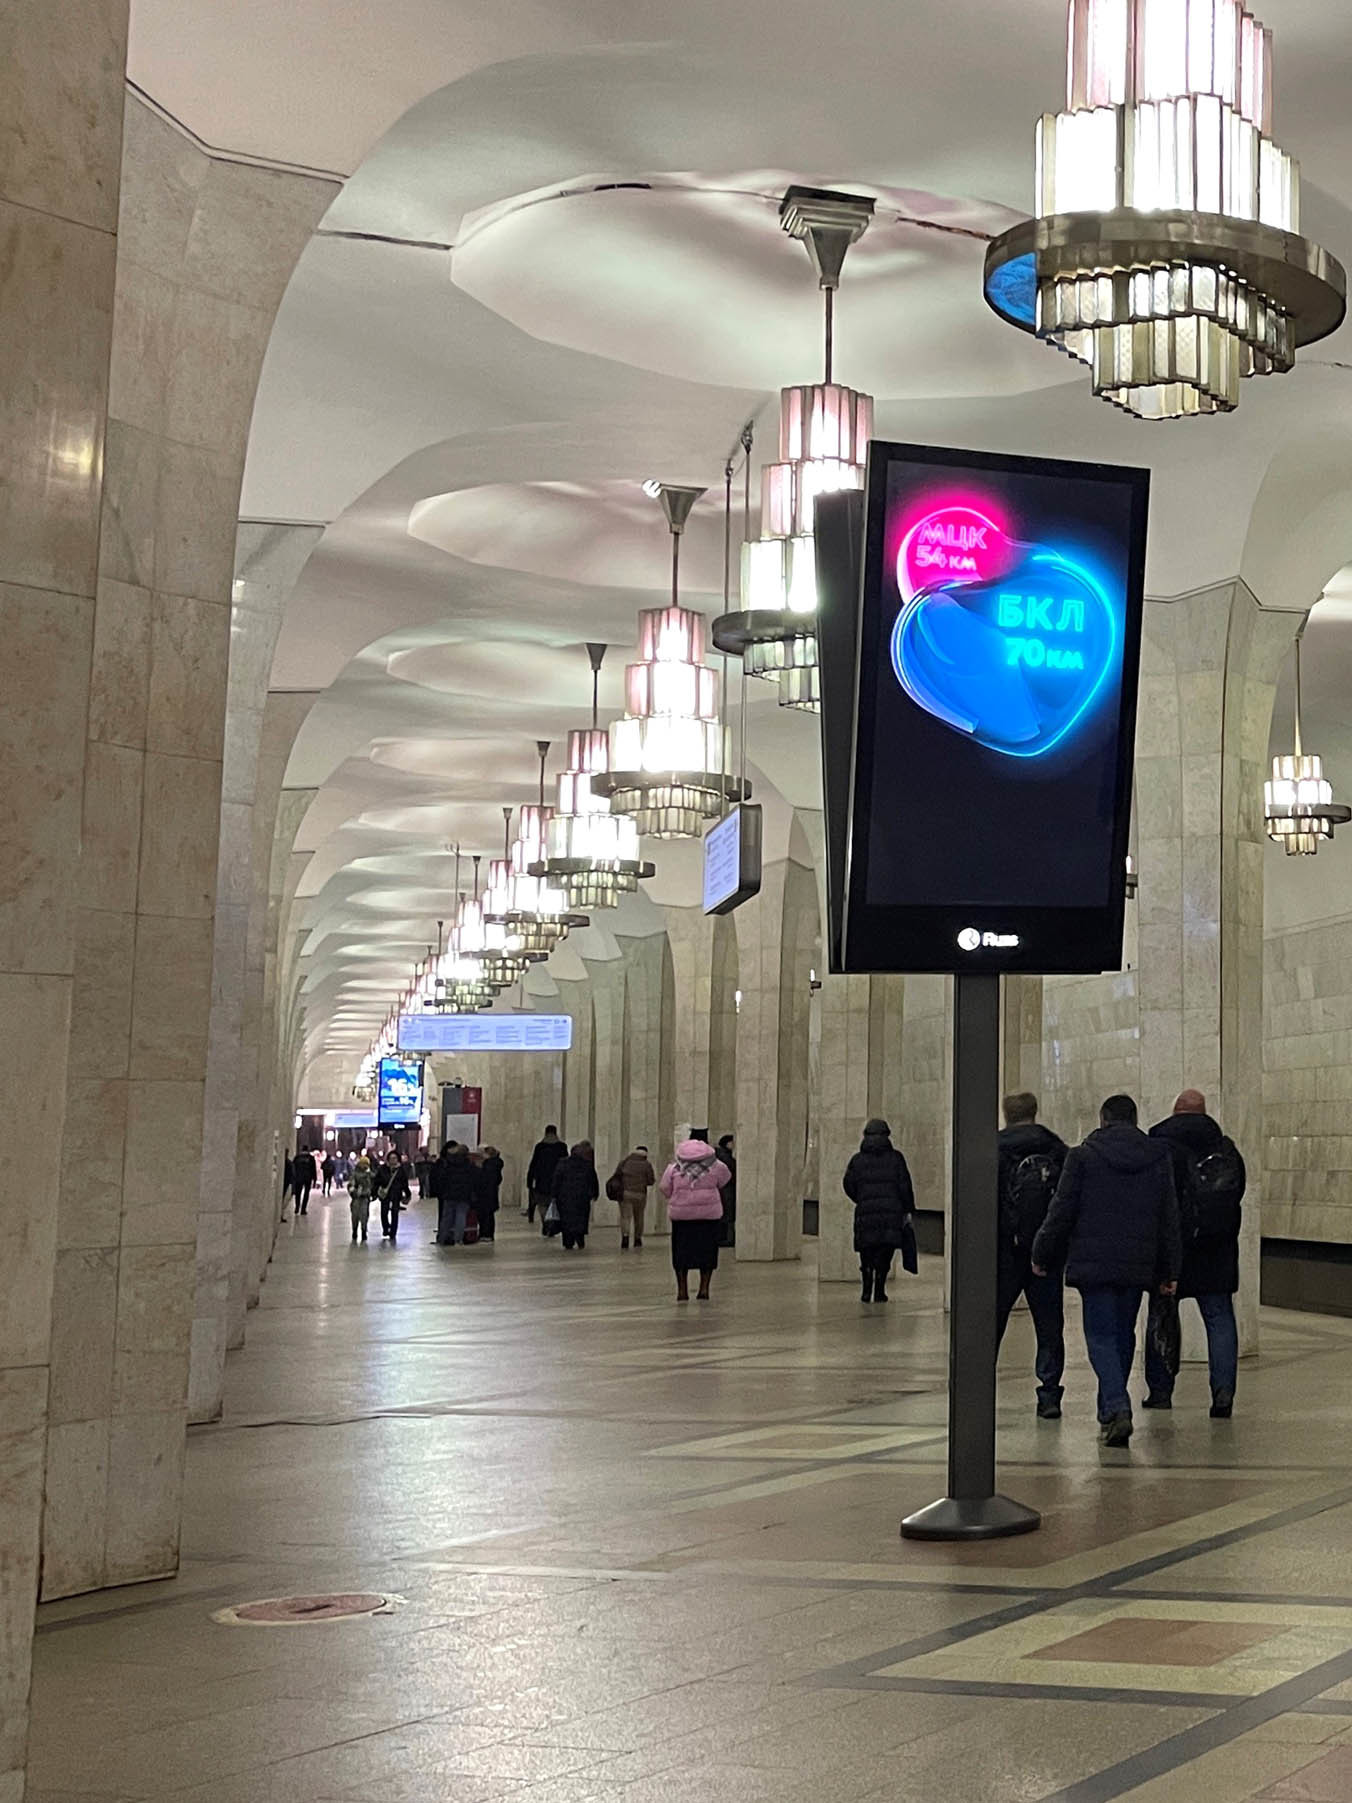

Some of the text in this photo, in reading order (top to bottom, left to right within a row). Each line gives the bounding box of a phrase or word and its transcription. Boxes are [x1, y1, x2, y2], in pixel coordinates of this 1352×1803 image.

[919, 523, 987, 550] МЦК
[915, 545, 948, 568] 54
[998, 594, 1085, 632] БКЛ
[1005, 637, 1046, 667] 70
